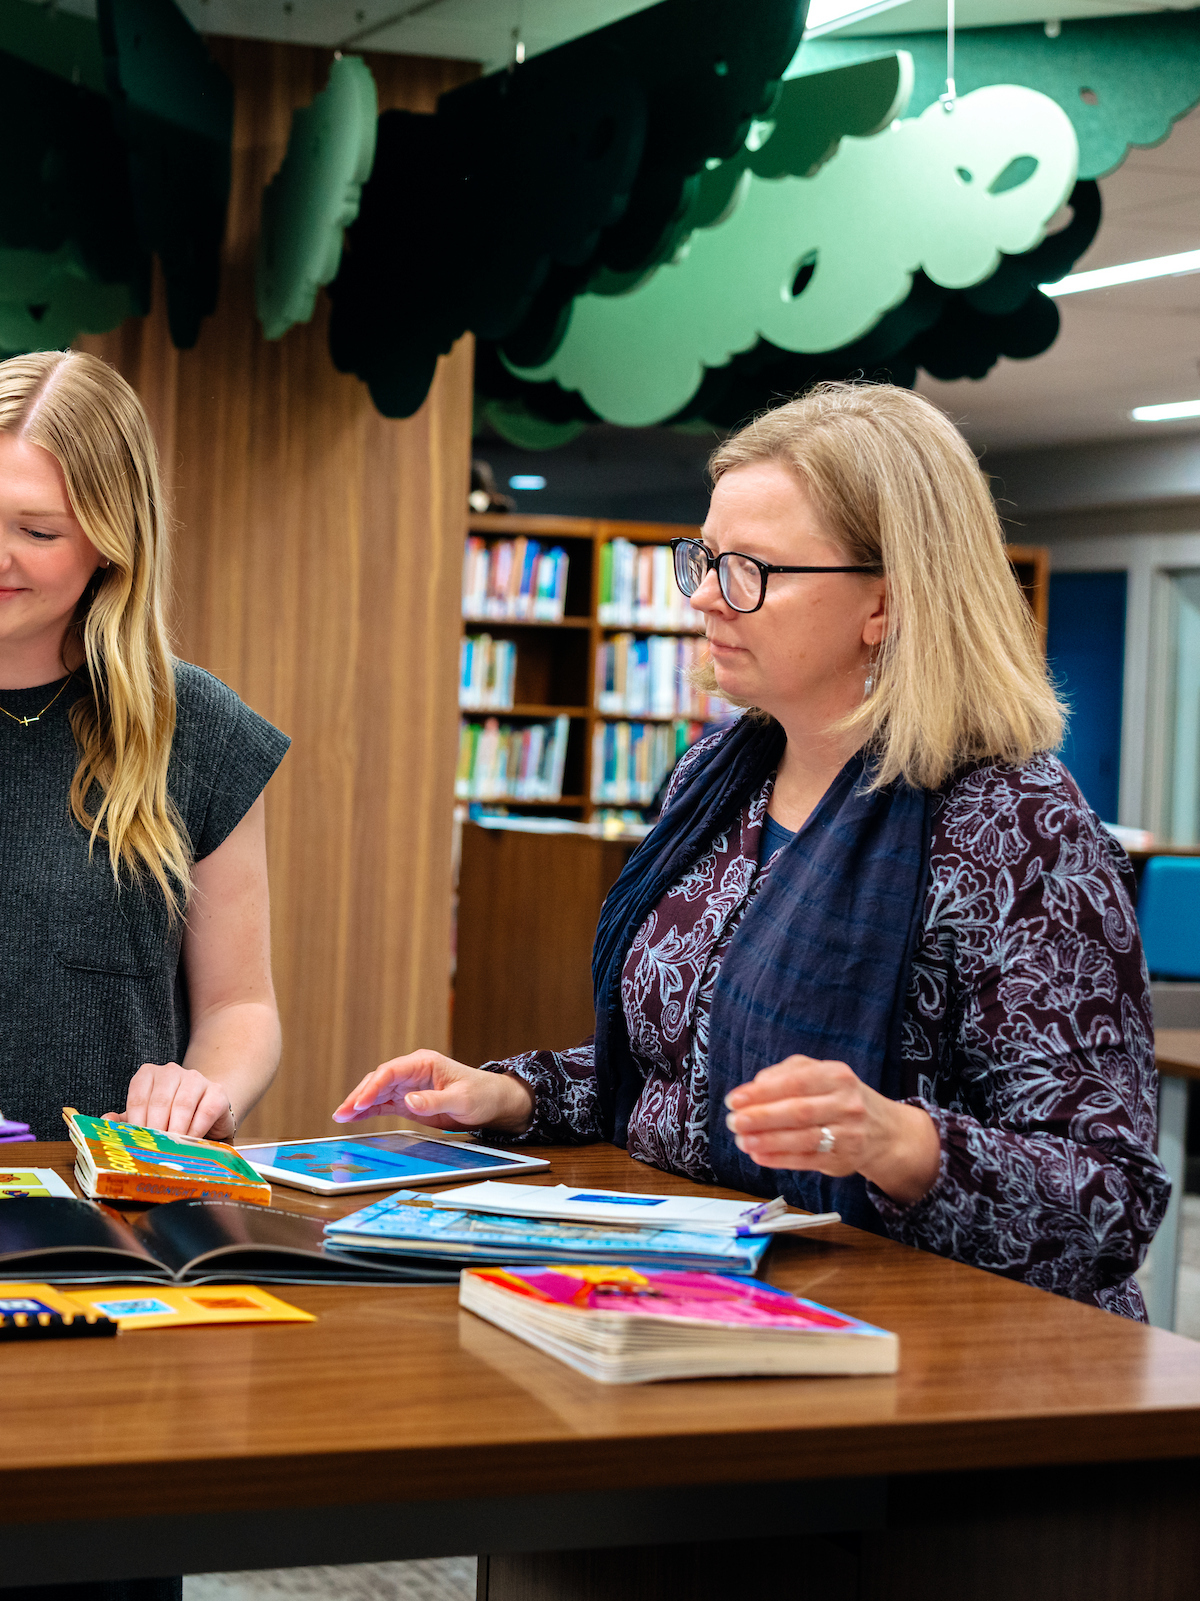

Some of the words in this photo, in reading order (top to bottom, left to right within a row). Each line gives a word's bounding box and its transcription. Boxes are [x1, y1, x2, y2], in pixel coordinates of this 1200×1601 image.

[91, 1120, 139, 1173] GOODNIGHT
[136, 1182, 197, 1198] GOODNIGHT
[200, 1190, 233, 1200] MOON
